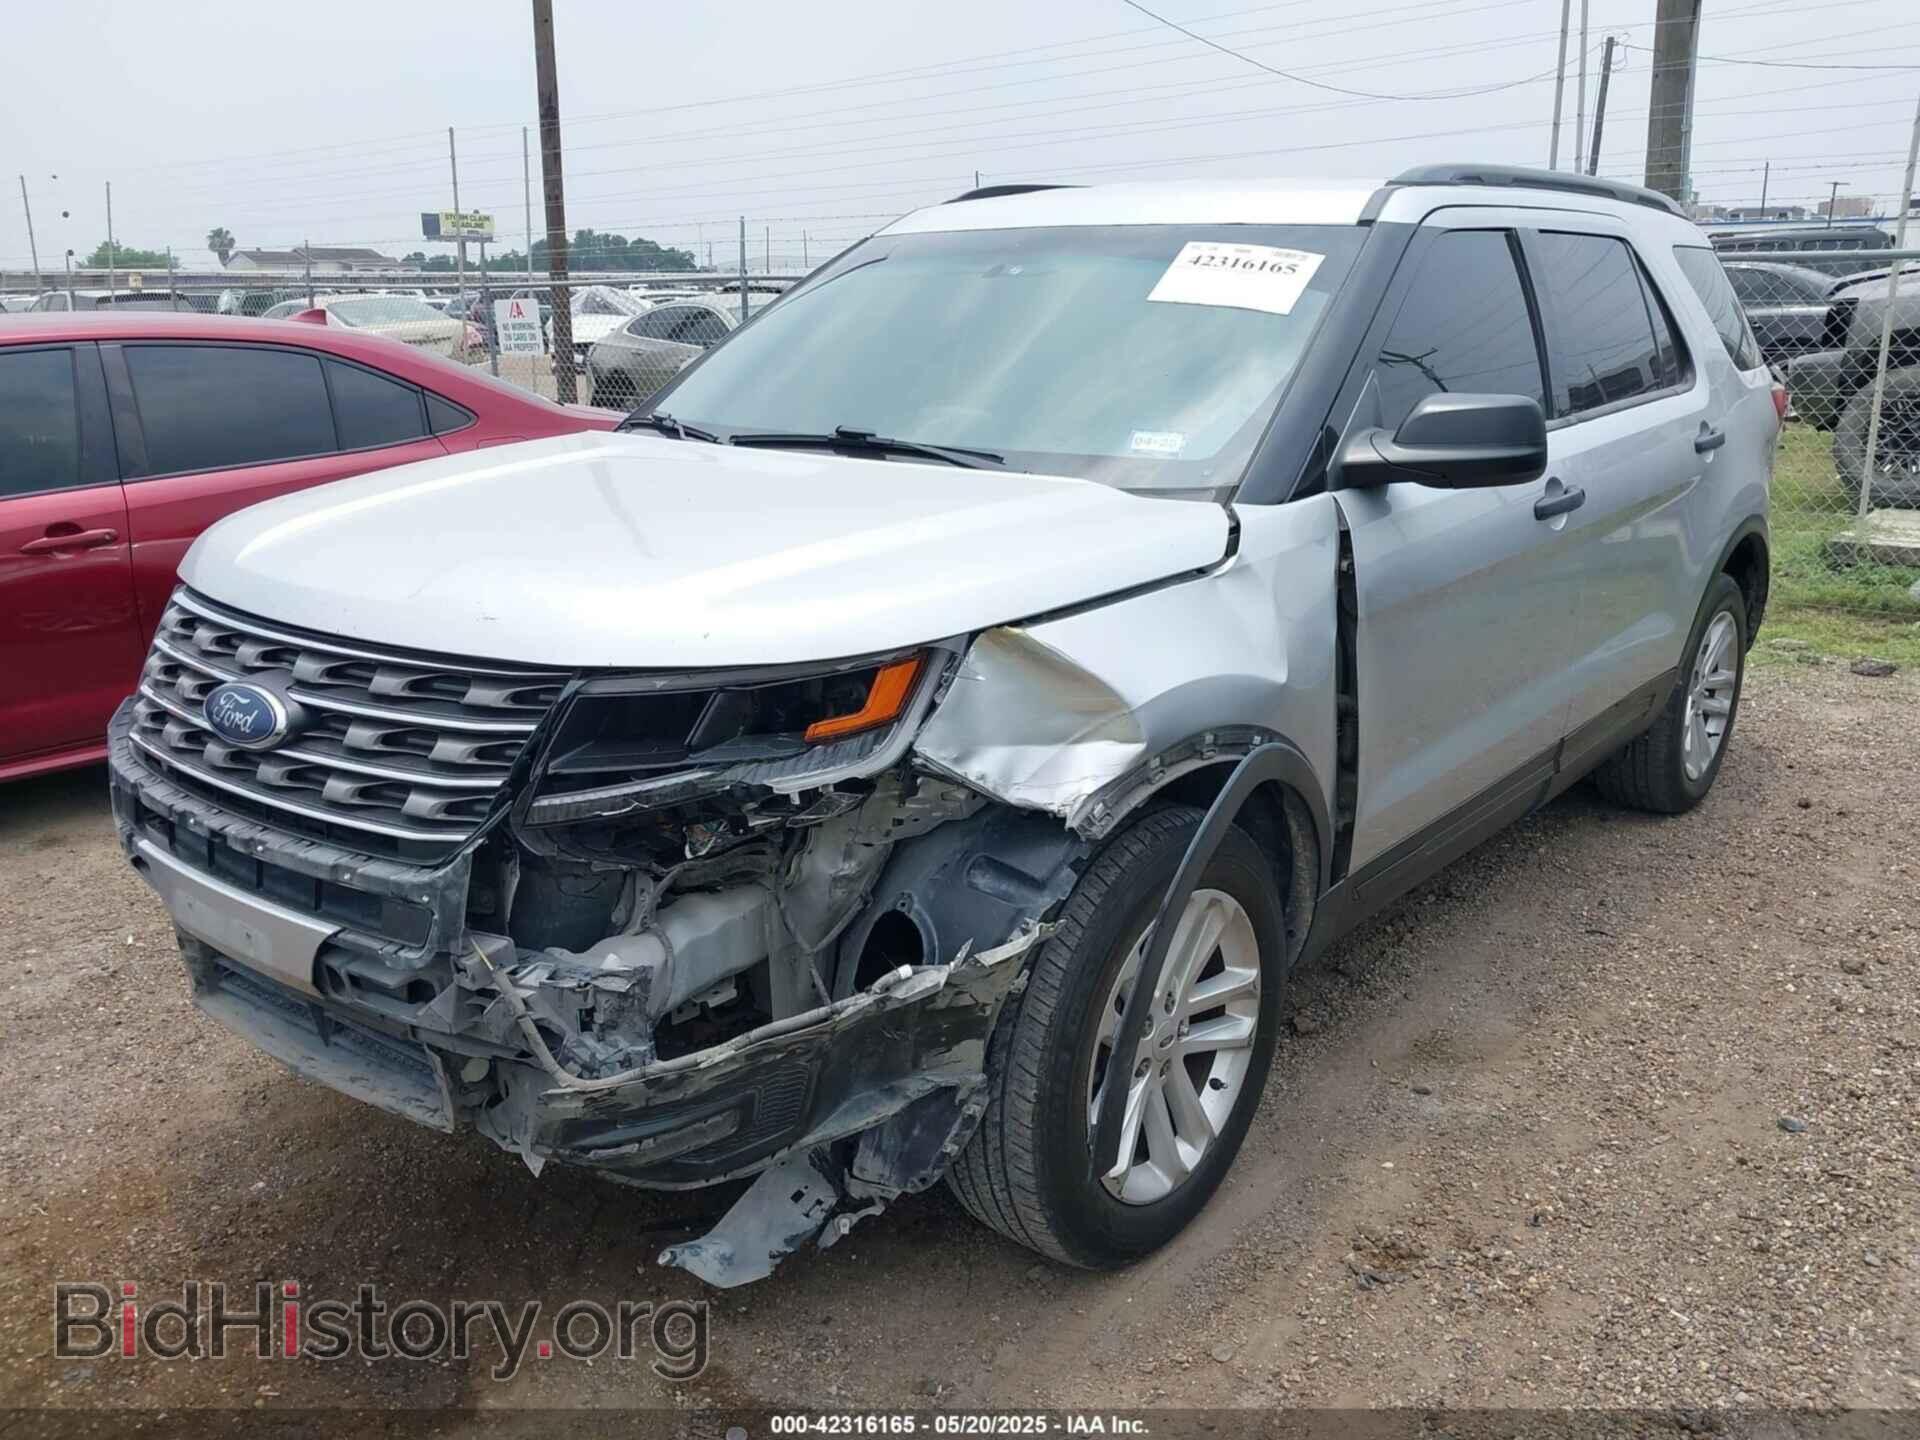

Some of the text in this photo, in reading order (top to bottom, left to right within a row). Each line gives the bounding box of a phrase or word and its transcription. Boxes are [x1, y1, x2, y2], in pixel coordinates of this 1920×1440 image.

[451, 221, 485, 229] DADLINE
[1188, 254, 1300, 275] 42316165
[212, 691, 259, 733] Ford
